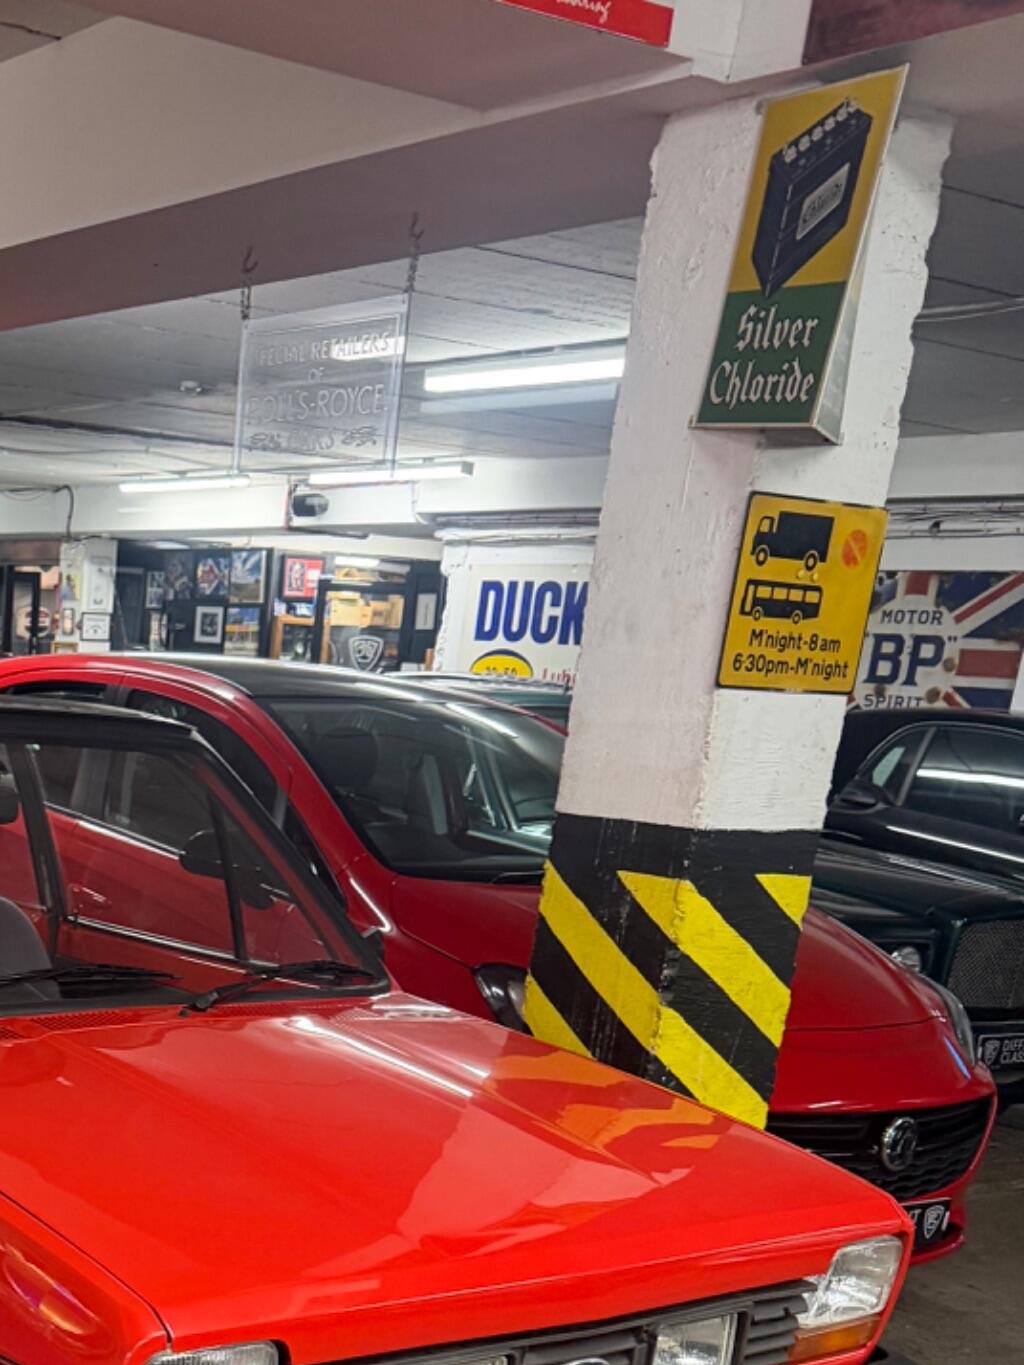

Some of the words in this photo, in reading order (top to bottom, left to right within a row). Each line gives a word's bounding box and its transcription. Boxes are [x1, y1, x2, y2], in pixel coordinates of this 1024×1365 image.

[311, 332, 390, 359] RETAILERS
[735, 303, 818, 351] Silver
[709, 356, 815, 410] Chloride
[474, 580, 589, 646] DUCK
[880, 609, 944, 625] MOTOR
[863, 693, 924, 709] SPIRIT
